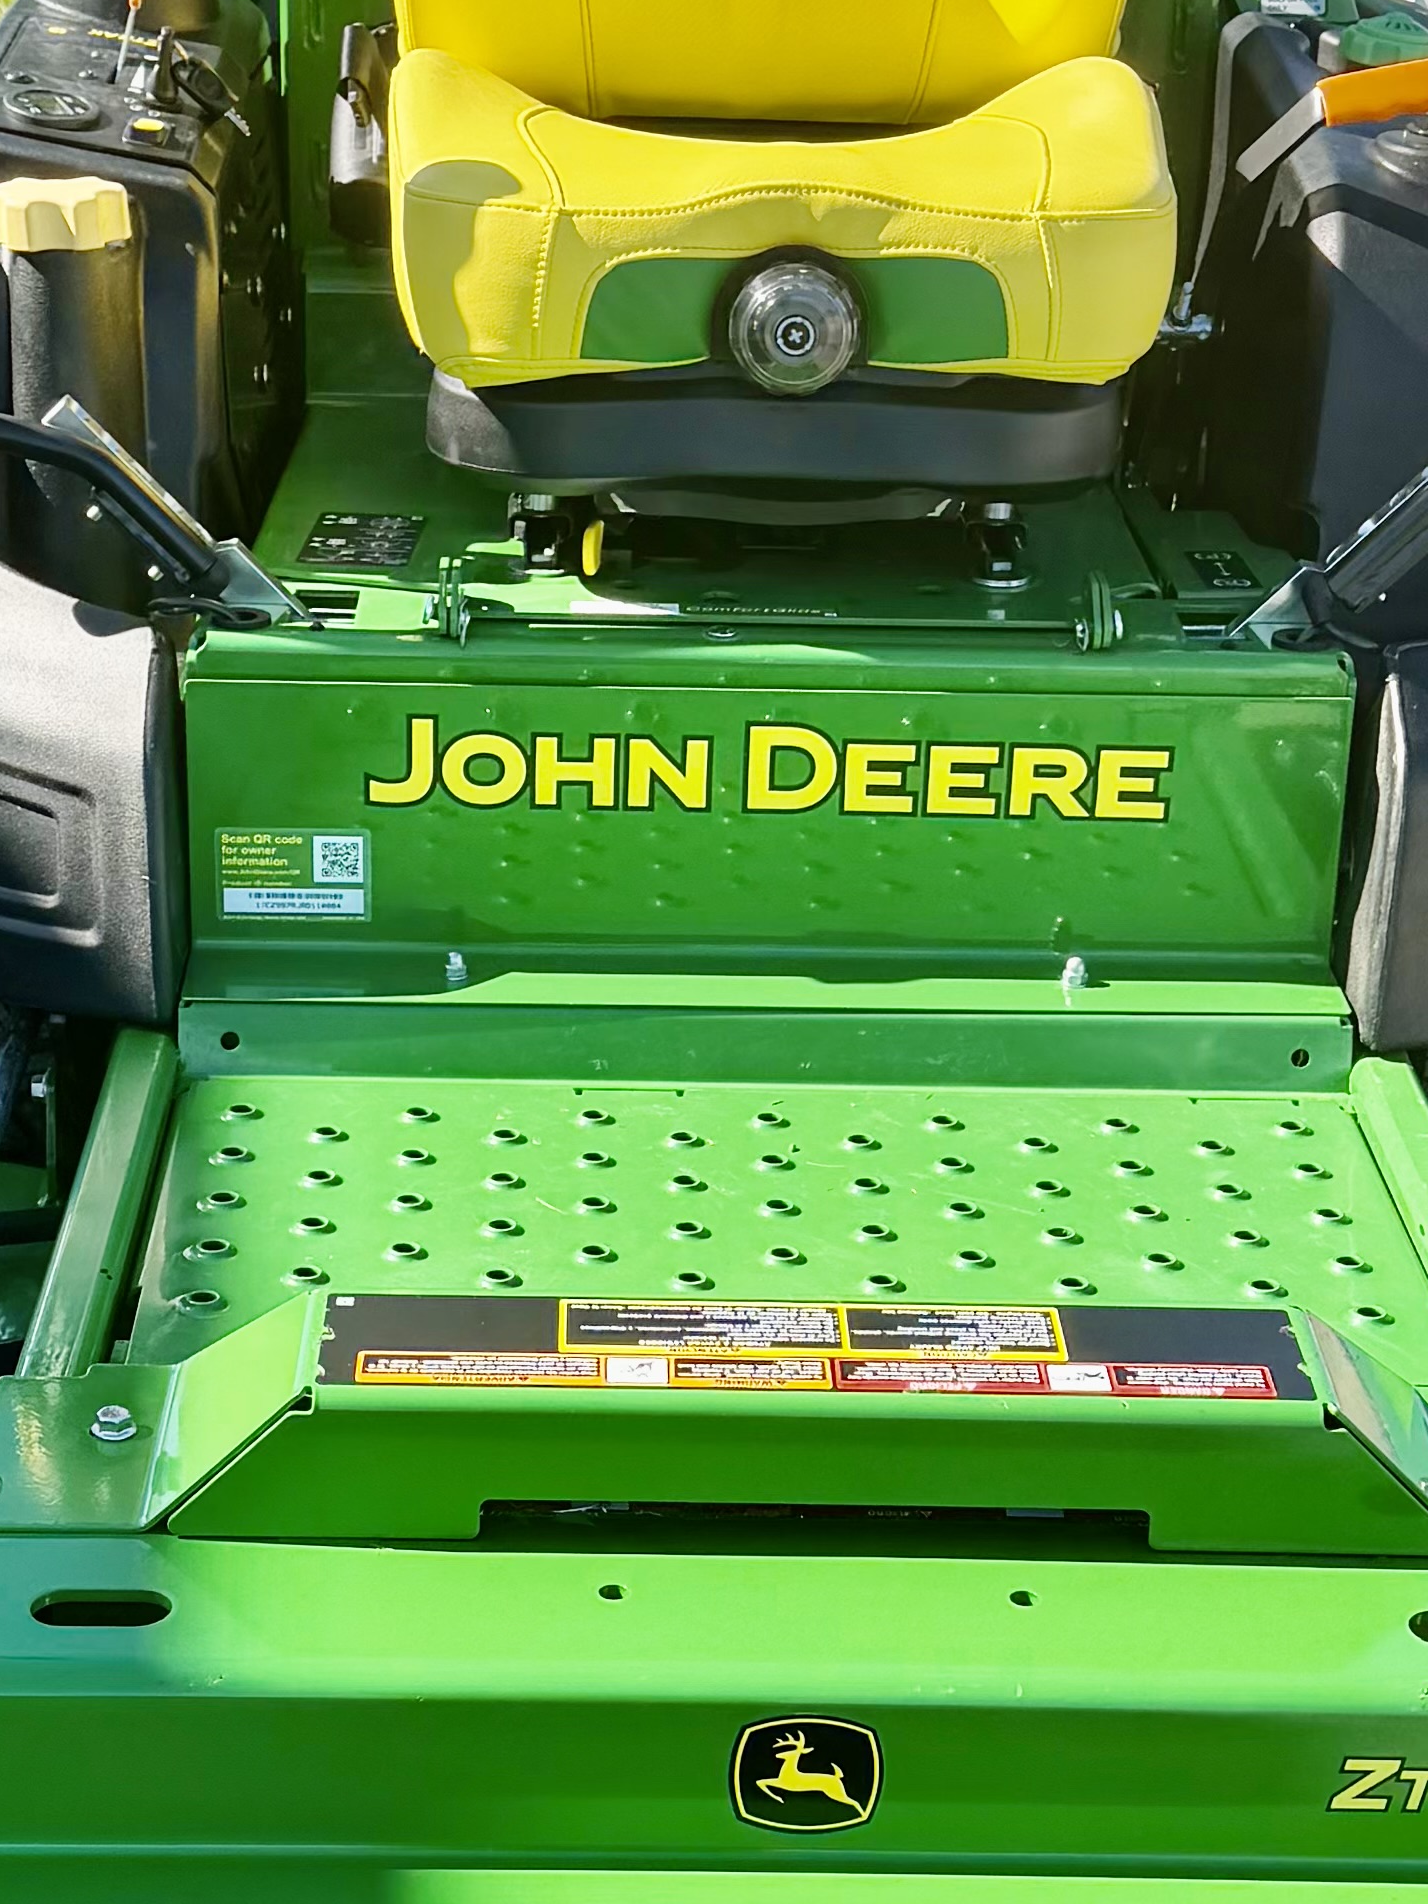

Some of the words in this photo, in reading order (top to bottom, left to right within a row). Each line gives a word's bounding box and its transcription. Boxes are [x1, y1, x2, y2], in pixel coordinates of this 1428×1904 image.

[367, 716, 712, 812] JOHN
[744, 723, 1172, 821] DEERE
[221, 833, 250, 844] Scan
[253, 834, 272, 844] QR
[274, 835, 303, 845] code
[221, 845, 238, 855] for
[241, 846, 276, 856] owner
[222, 855, 288, 866] information
